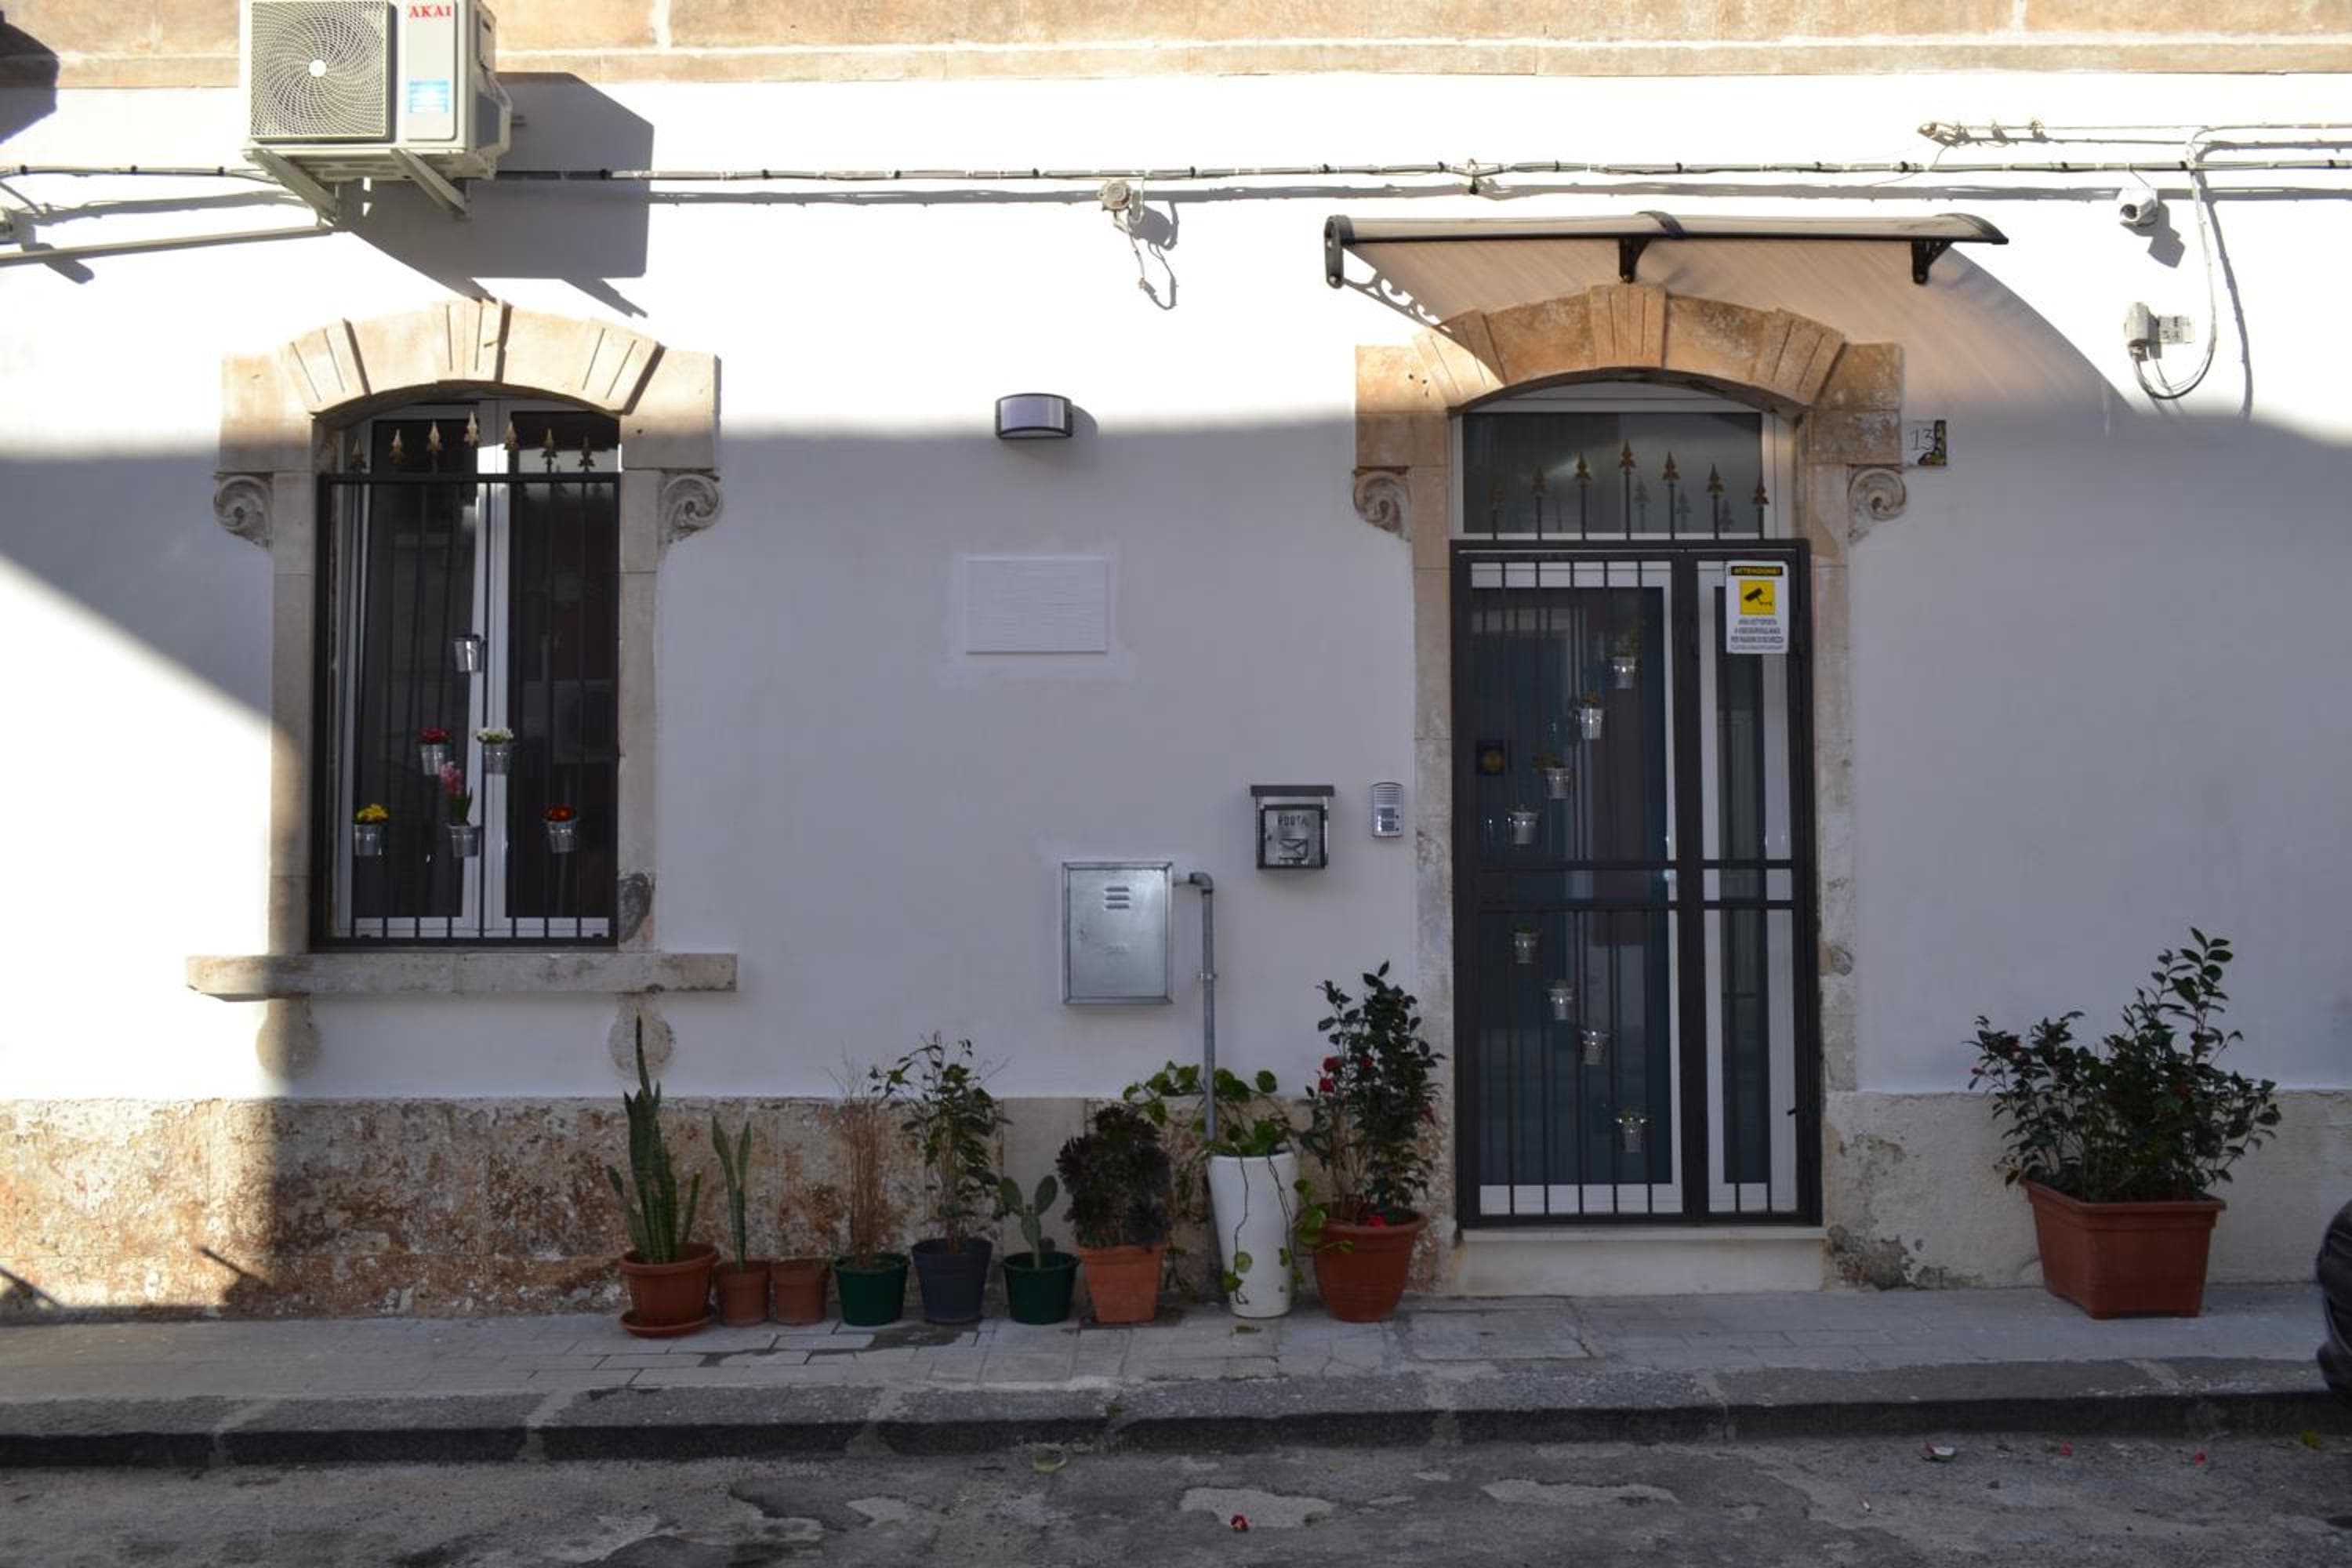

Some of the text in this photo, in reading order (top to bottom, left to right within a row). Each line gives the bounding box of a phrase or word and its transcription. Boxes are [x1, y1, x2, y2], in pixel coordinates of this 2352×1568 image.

[408, 5, 452, 17] AKAI
[1911, 427, 1934, 450] 13
[1278, 815, 1310, 827] POSTA
